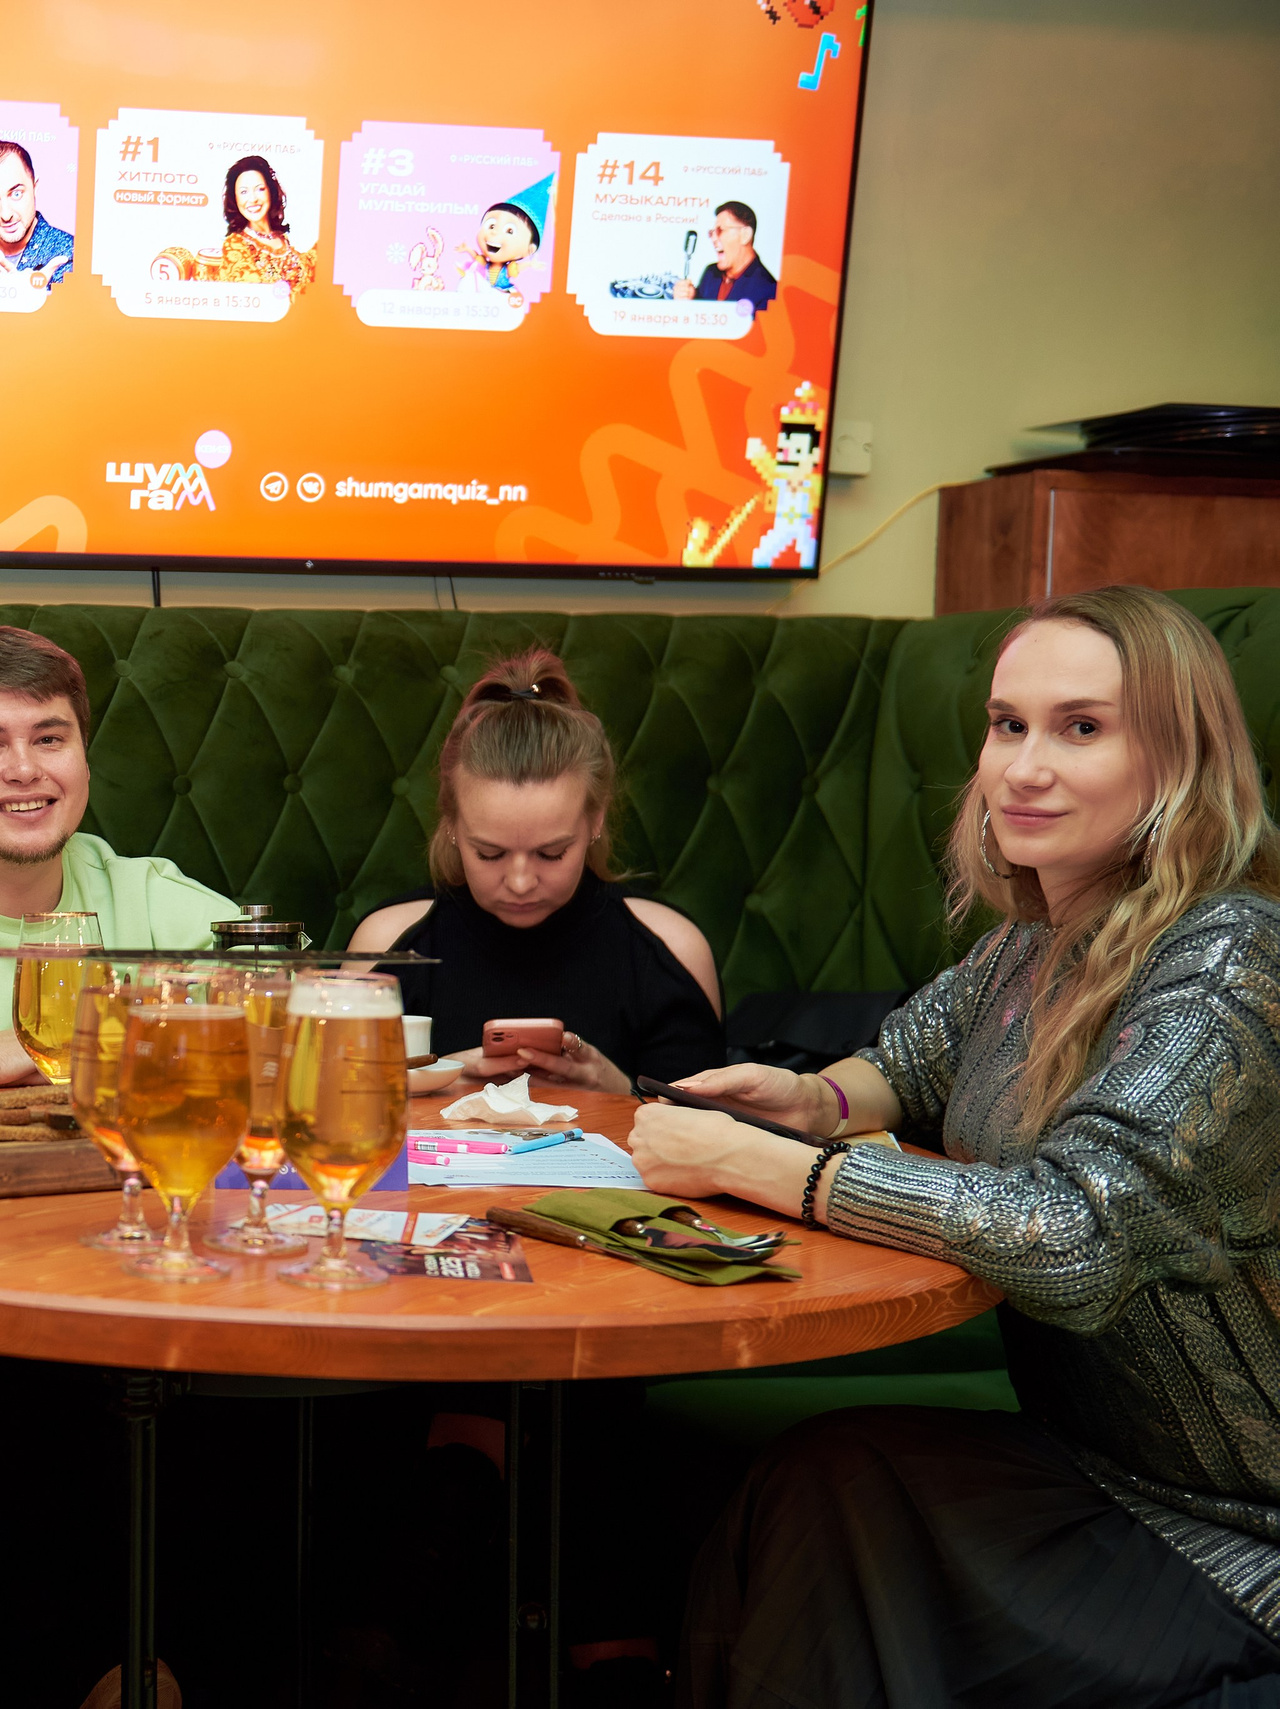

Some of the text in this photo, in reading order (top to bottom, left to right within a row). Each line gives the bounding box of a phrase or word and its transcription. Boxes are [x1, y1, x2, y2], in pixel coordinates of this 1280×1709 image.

[119, 136, 160, 163] #1
[360, 148, 415, 177] #3
[117, 171, 198, 184] ХИТЛОТО
[597, 159, 664, 186] #14
[360, 182, 425, 197] УГАДАЙ
[115, 191, 205, 206] новый формат
[594, 193, 710, 208] МУЗЫКАЛИТИ
[358, 199, 479, 215] МУЛЬТФИЛЬМ
[592, 210, 642, 222] Сделано
[655, 213, 699, 224] России!
[145, 293, 153, 304] 5
[157, 296, 208, 309] января
[225, 296, 261, 308] 15:30
[381, 302, 395, 314] 12
[399, 305, 449, 319] января
[465, 305, 500, 318] 15:30
[613, 311, 626, 321] 19
[630, 313, 679, 326] января
[695, 313, 728, 325] 15:30
[335, 476, 527, 505] shumgamquiz_nn
